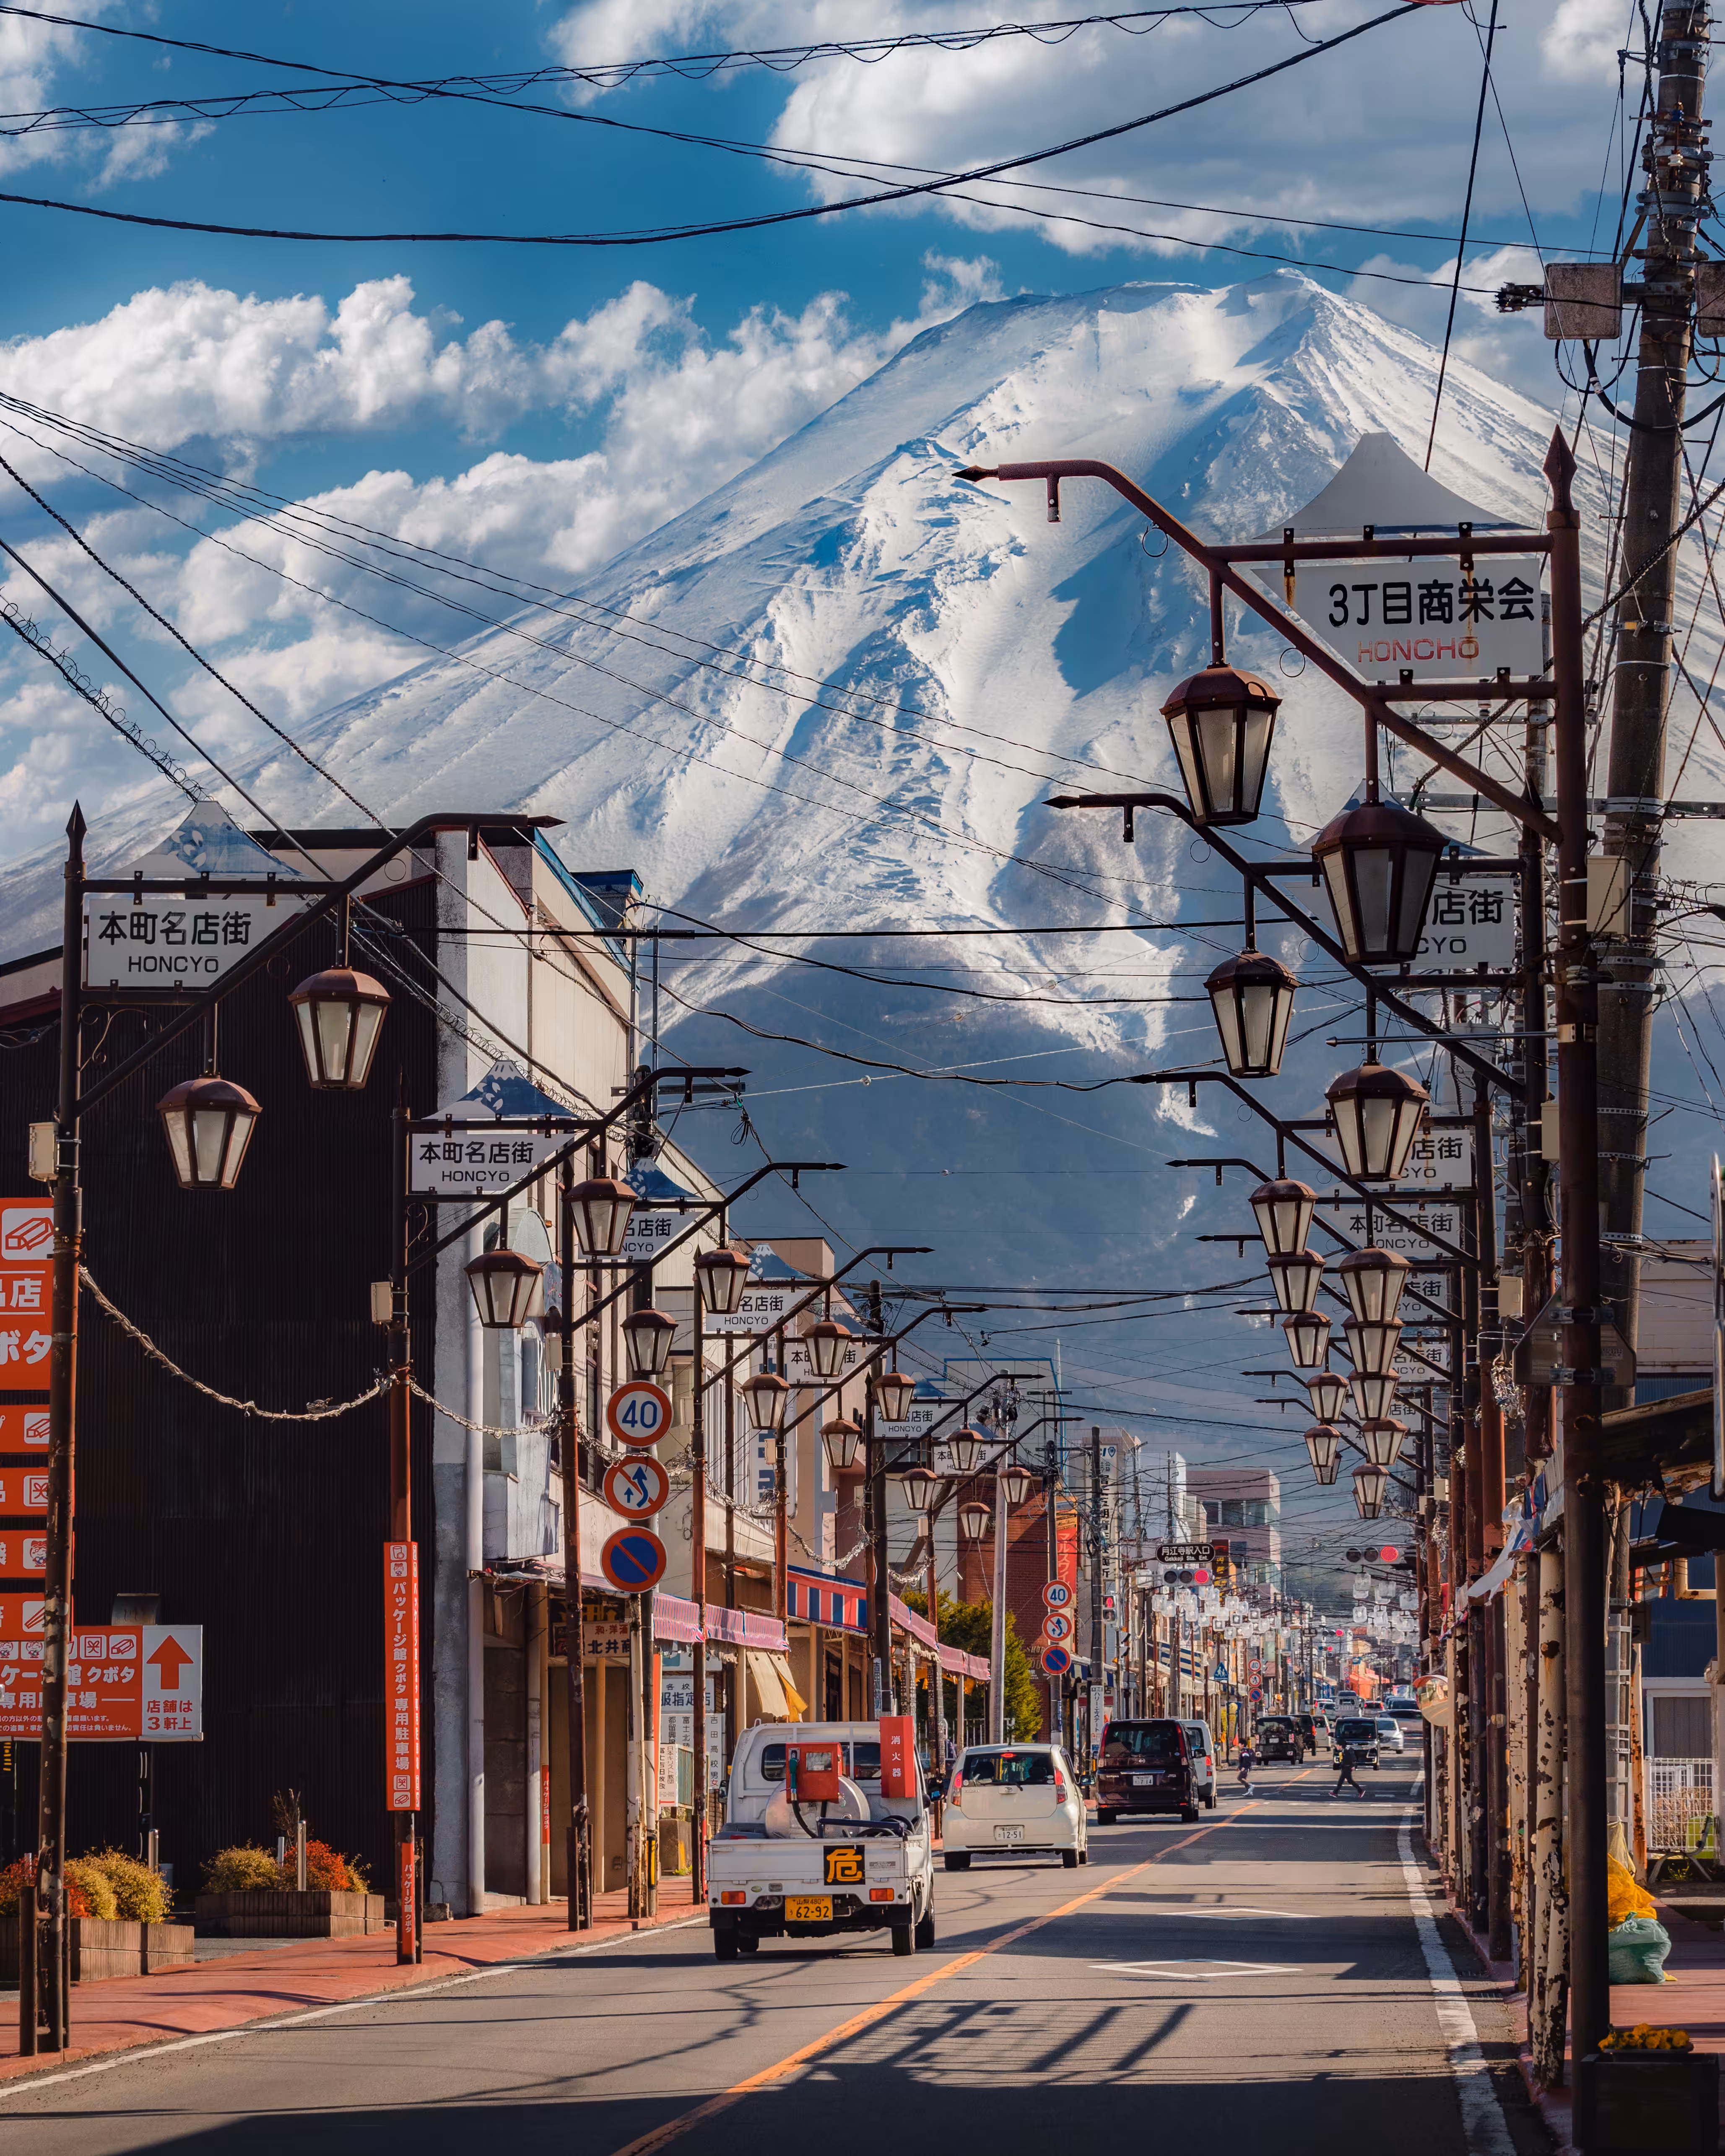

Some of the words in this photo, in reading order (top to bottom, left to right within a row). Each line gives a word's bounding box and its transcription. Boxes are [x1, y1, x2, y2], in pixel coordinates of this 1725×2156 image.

[1328, 577, 1534, 627] 3丁目商栄会
[1431, 889, 1503, 925] 店街
[98, 911, 251, 946] 本町名店街
[419, 1141, 533, 1164] 本町名店街
[1411, 1137, 1463, 1160] 店街
[625, 1218, 672, 1237] 名店街
[622, 1242, 654, 1252] NCYŌ
[1374, 1239, 1429, 1249] ONCYŌ
[0, 1278, 42, 1308] 店
[622, 1400, 657, 1429] 40
[1162, 1546, 1210, 1556] 月江寺駅入口
[1050, 1588, 1065, 1601] 40
[392, 1582, 407, 1660] パッケージ館
[87, 1666, 135, 1683] クボタ
[395, 1663, 407, 1694] クボタ
[0, 1691, 97, 1709] 専用車場
[147, 1700, 192, 1713] 店舗は
[148, 1717, 192, 1731] 3軒上
[395, 1698, 410, 1770] 専用駐車場
[891, 1735, 901, 1777] 消火器
[826, 1848, 862, 1883] 危
[796, 1906, 829, 1918] 62-92
